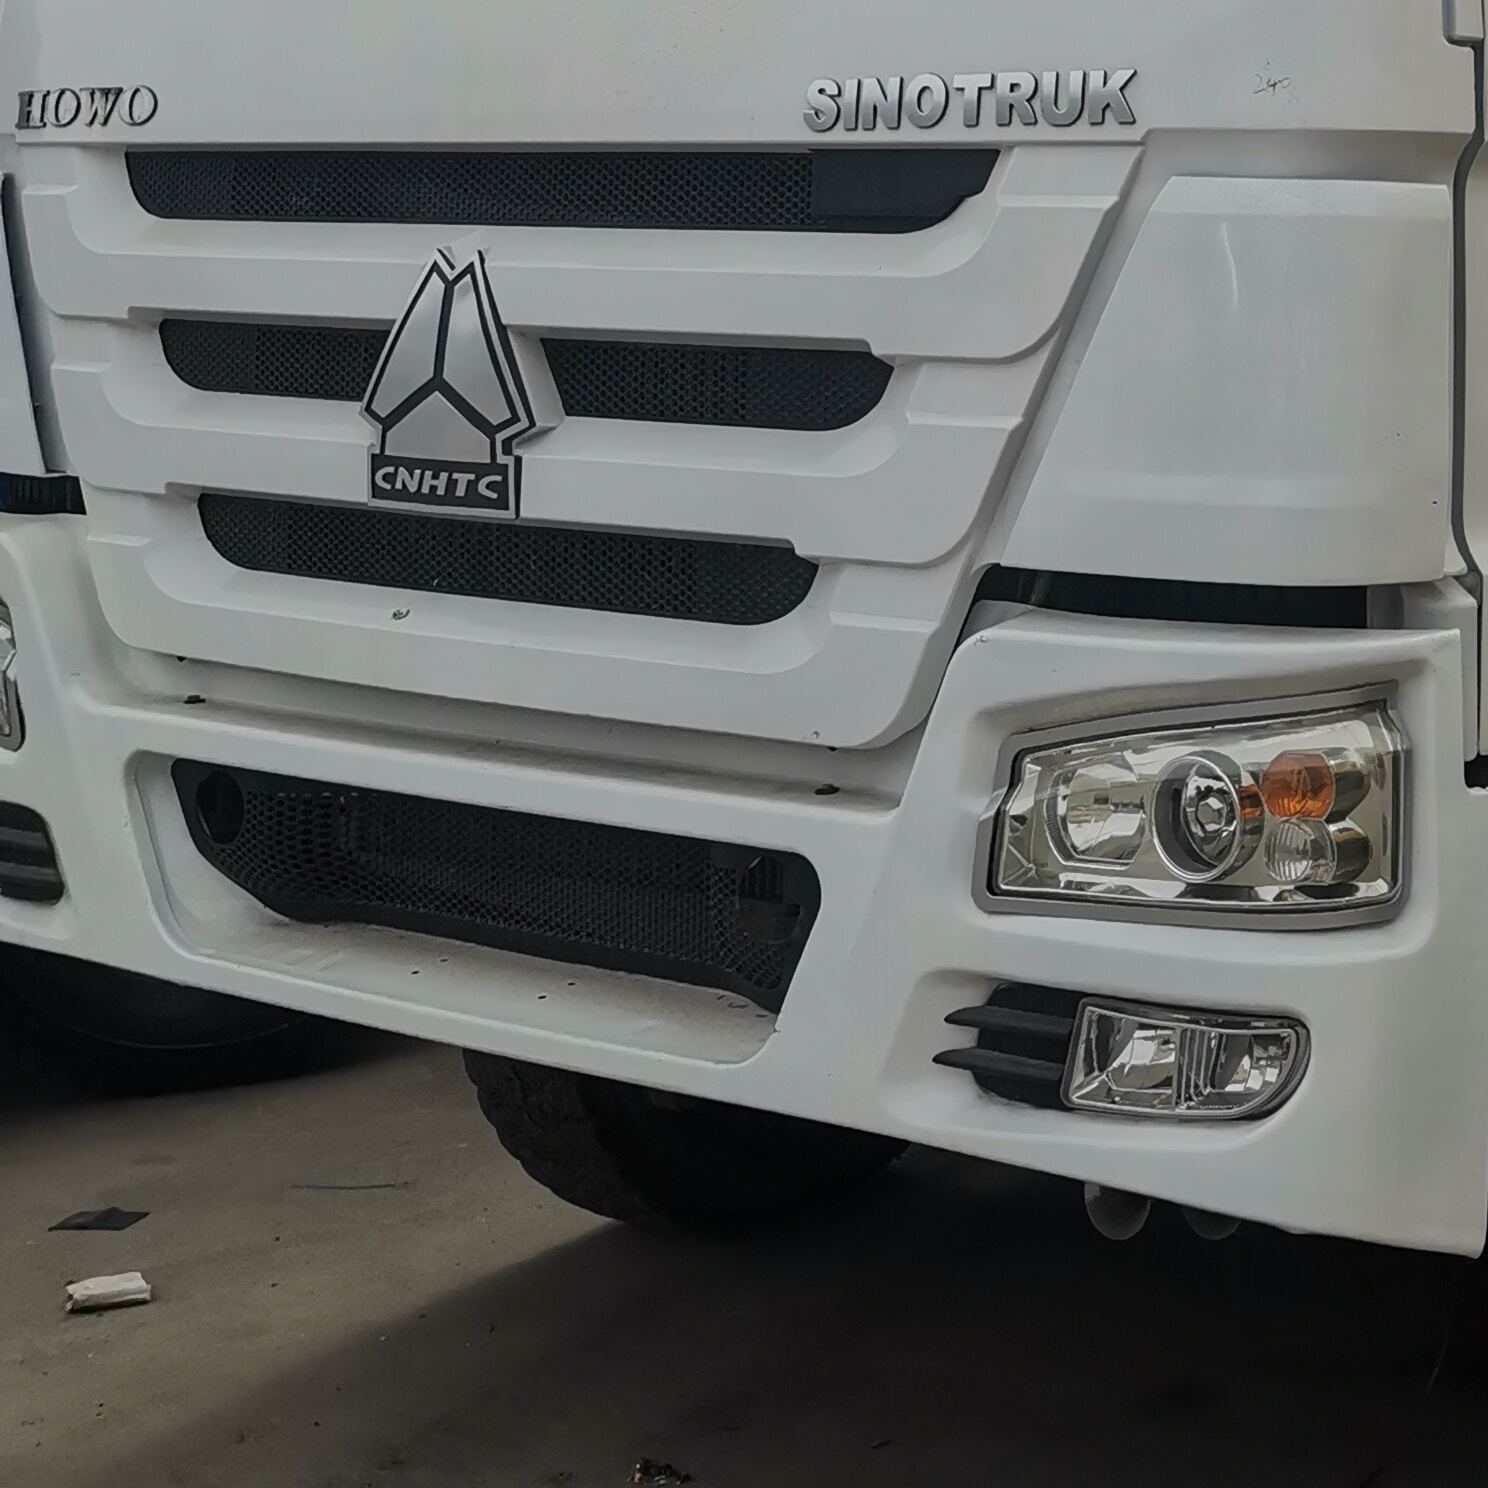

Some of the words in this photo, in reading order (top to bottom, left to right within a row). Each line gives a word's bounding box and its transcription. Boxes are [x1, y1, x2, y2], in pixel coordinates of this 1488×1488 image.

[15, 84, 159, 130] HOWO
[803, 69, 1137, 133] SINOTRUK
[374, 466, 503, 500] CNHTC
